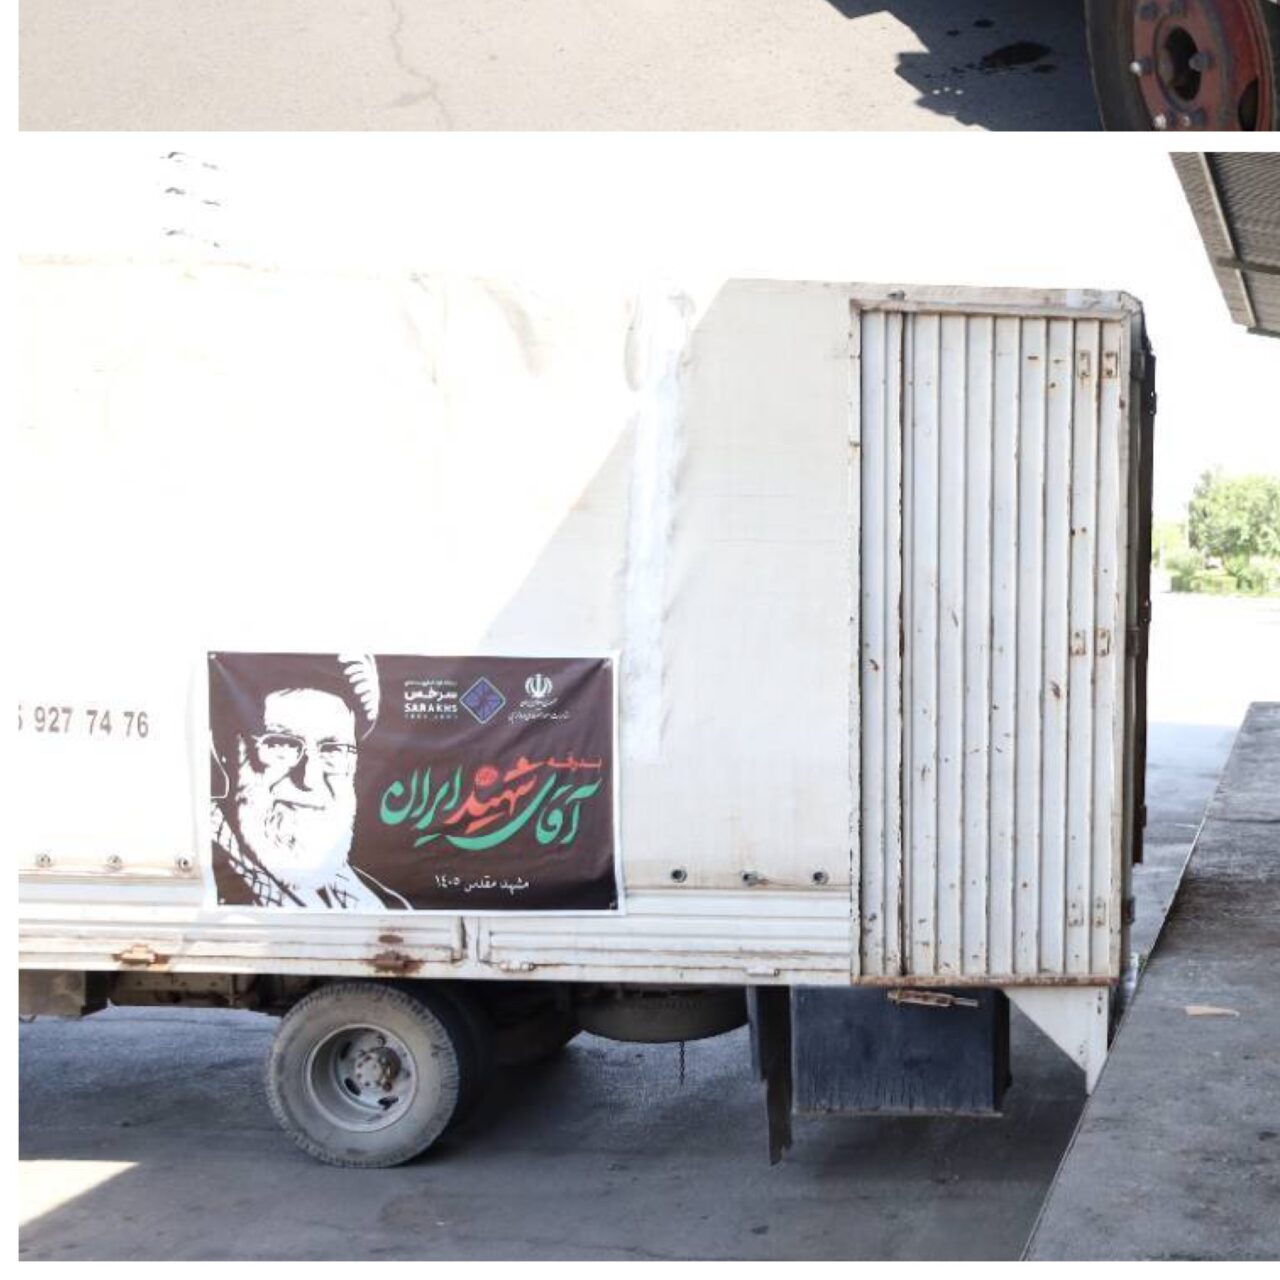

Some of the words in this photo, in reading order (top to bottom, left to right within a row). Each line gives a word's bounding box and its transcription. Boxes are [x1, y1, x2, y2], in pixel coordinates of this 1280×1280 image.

[404, 686, 459, 702] سرخس
[404, 703, 459, 713] SARAKHS
[34, 706, 73, 733] 927
[86, 709, 112, 735] 74
[124, 711, 149, 738] 76
[379, 765, 463, 848] ایران
[443, 756, 543, 835] شهید
[446, 771, 602, 851] آقای
[464, 875, 498, 893] مقدس
[500, 877, 530, 895] مشهد
